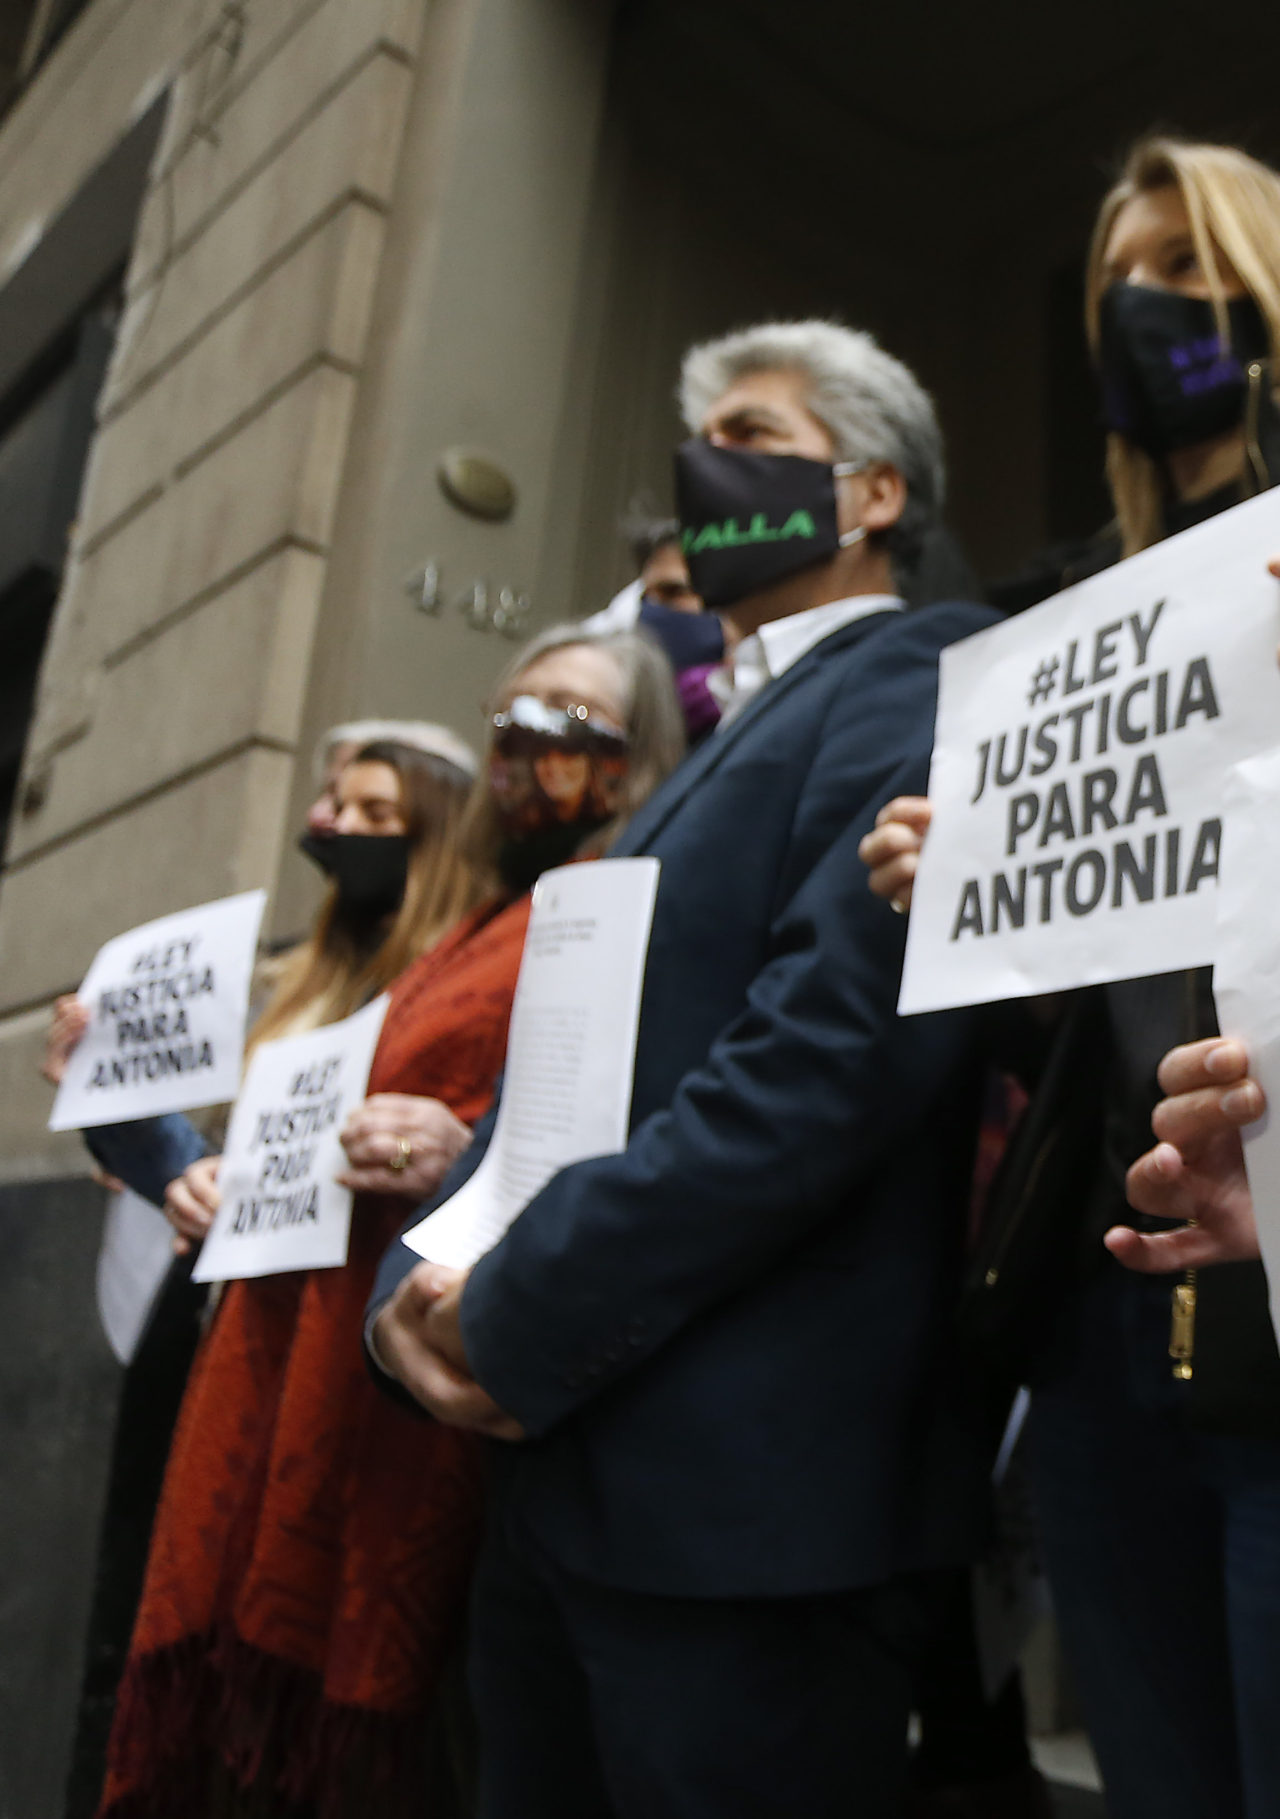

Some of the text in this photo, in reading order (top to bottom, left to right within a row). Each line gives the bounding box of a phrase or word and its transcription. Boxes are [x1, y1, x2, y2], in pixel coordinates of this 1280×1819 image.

[1028, 598, 1167, 706] #LEY
[970, 655, 1220, 805] JUSTICIA
[1005, 752, 1168, 856] PARA
[950, 817, 1222, 942] ANTONIA
[99, 966, 214, 1023] JUSTICIA
[117, 1008, 188, 1047] PARA
[87, 1041, 214, 1090] ANTONIA
